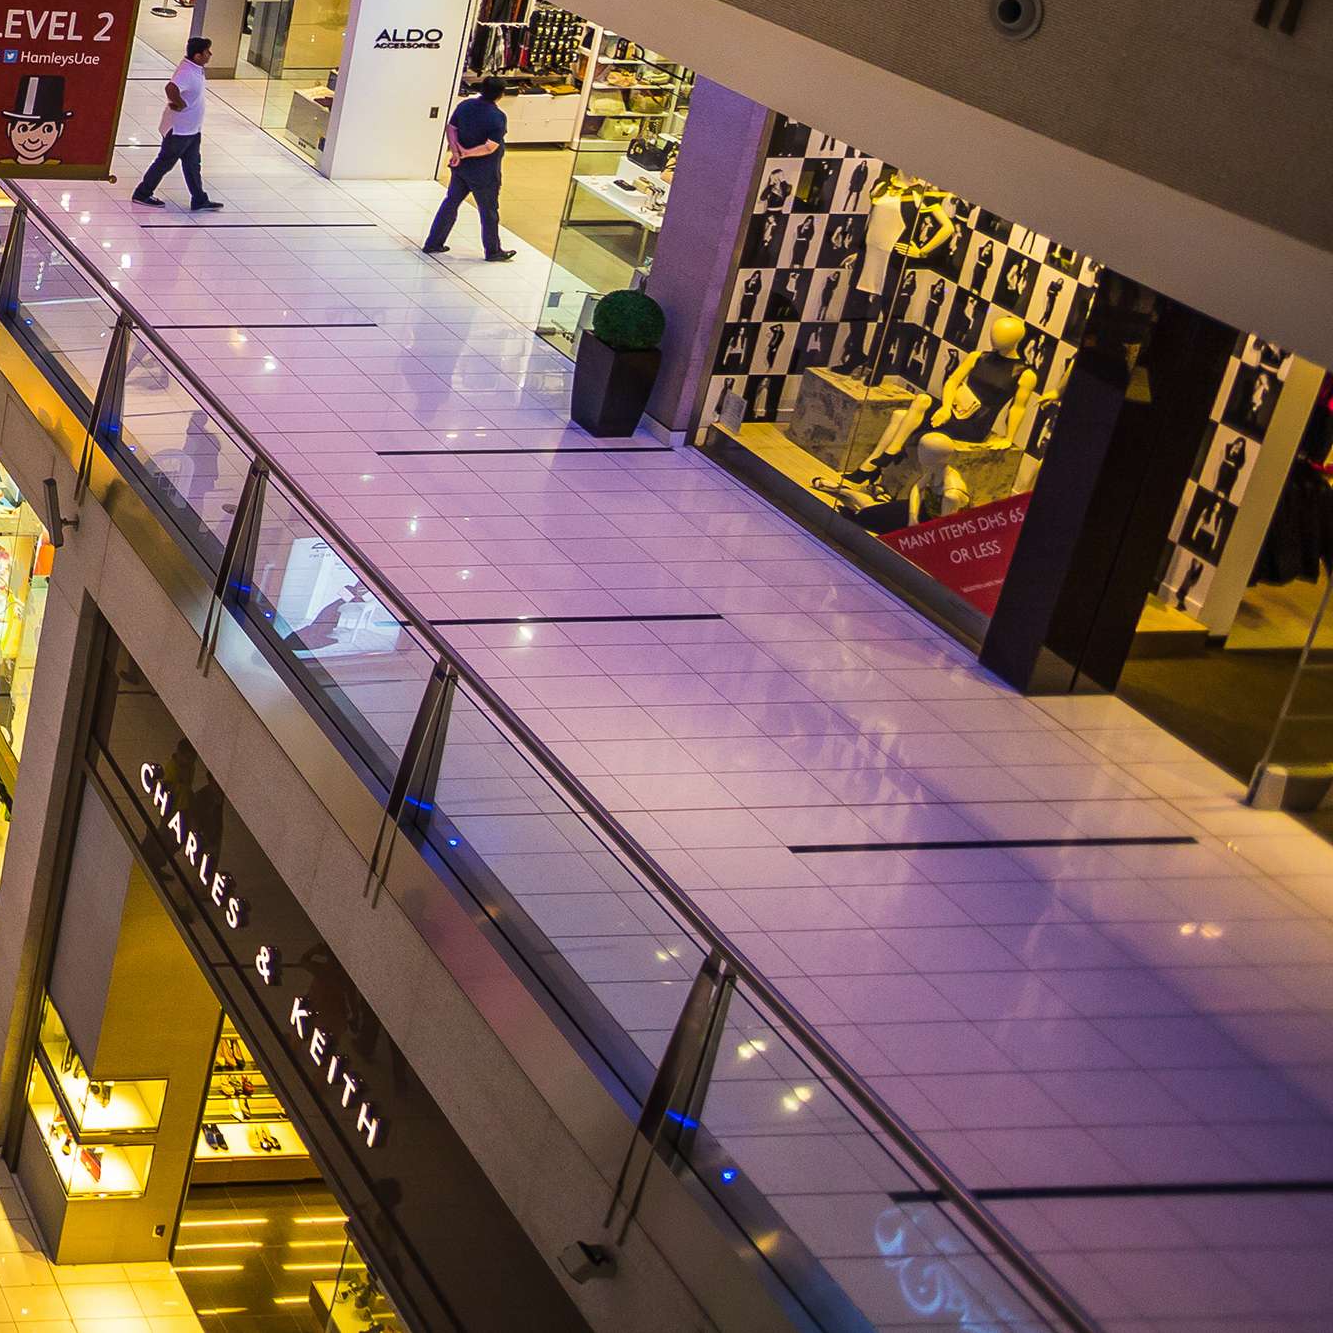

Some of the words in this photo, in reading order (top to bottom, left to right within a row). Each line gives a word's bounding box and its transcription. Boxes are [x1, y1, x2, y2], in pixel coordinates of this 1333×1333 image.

[93, 12, 114, 42] 2
[375, 29, 443, 42] ALDO
[20, 52, 100, 66] HamleysUae
[898, 530, 935, 551] MANY
[938, 520, 977, 542] ITEMS
[977, 512, 1008, 531] DHS
[1009, 507, 1025, 523] 65
[950, 548, 973, 563] OR
[973, 540, 1001, 558] LESS
[139, 761, 243, 931] CHARLES
[254, 944, 279, 986] &
[289, 995, 383, 1150] KEITH
